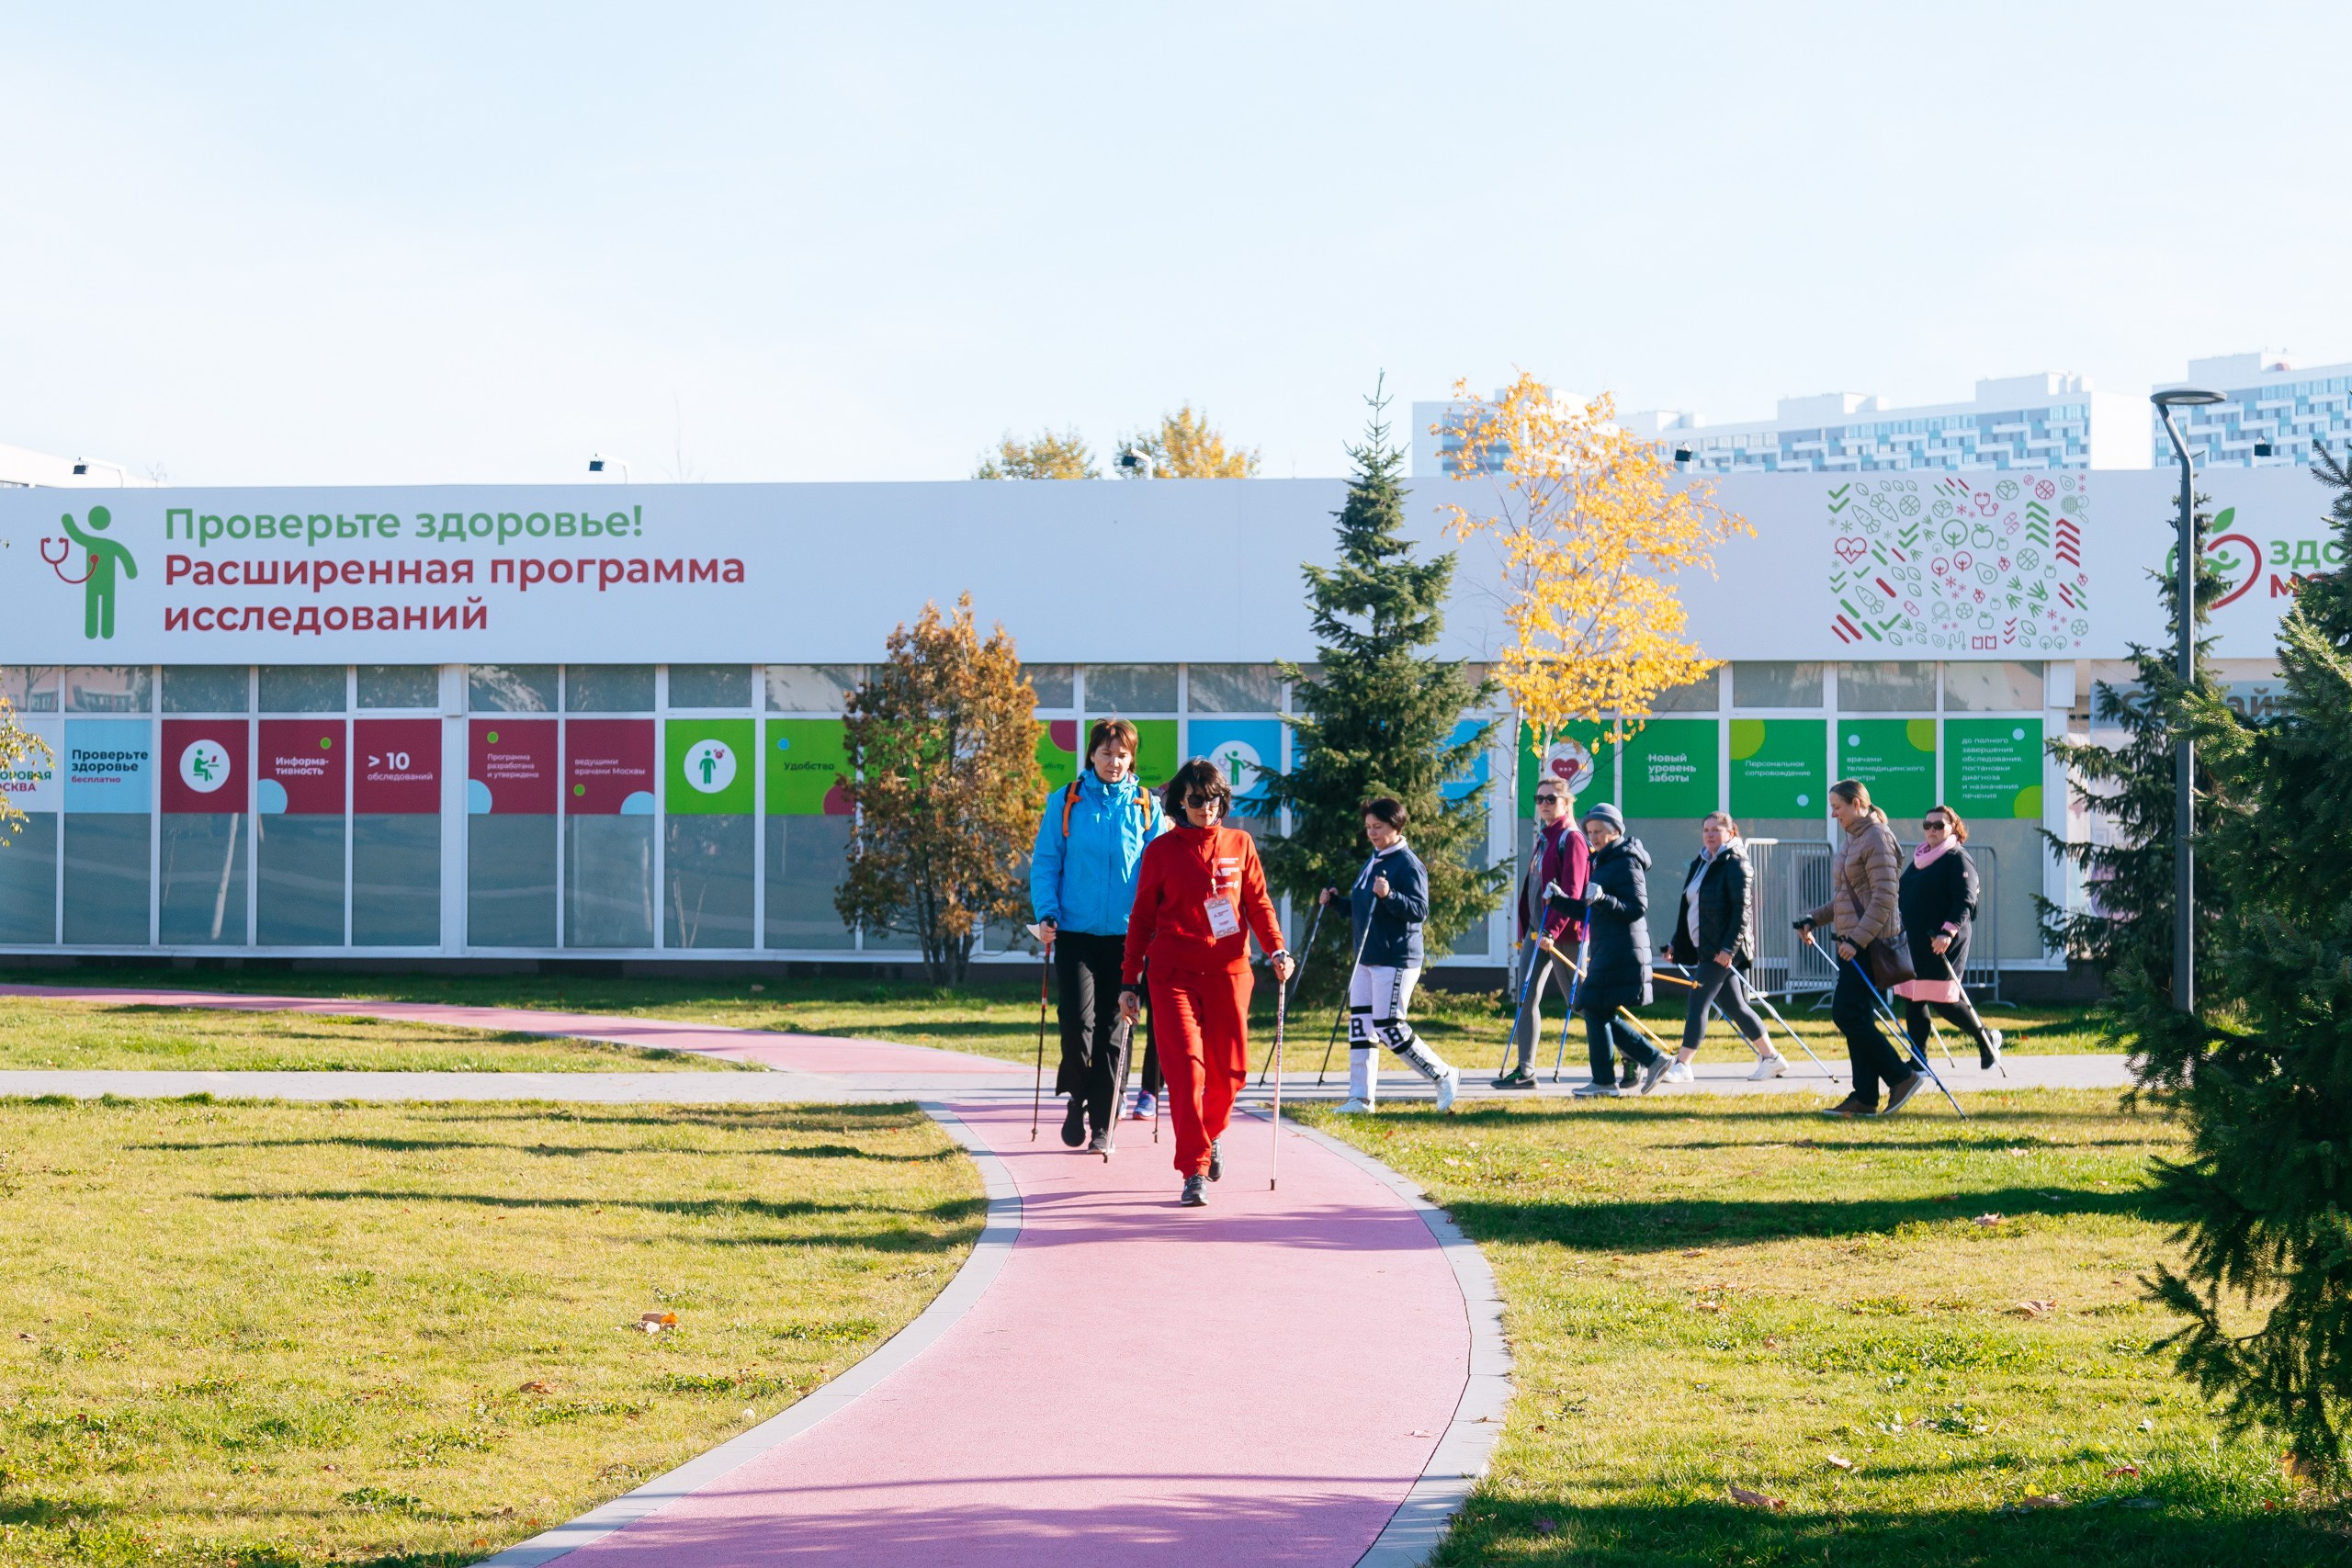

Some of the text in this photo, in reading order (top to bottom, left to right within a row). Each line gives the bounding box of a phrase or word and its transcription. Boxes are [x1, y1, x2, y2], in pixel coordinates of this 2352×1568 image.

[165, 504, 642, 548] Проверьте здоровье!
[165, 554, 745, 593] Расширенная программа
[164, 595, 488, 636] исследований
[72, 749, 149, 762] Проверьте
[486, 753, 531, 761] Программа
[1648, 752, 1688, 762] Новый
[275, 756, 329, 768] Информа-
[386, 751, 411, 771] 10
[574, 758, 619, 766] ведущими
[1745, 761, 1805, 769] Персональное
[72, 761, 139, 773] здоровье
[275, 767, 324, 776] тивность
[486, 762, 536, 771] разработана
[574, 766, 646, 776] врачами Москвы
[784, 761, 835, 772] Удобство
[1648, 764, 1697, 774] уровень
[367, 773, 434, 782] обследований
[1648, 773, 1690, 783] заботы
[1745, 770, 1812, 778] сопровождение
[71, 775, 121, 784] бесплатно
[0, 783, 36, 792] СКВА
